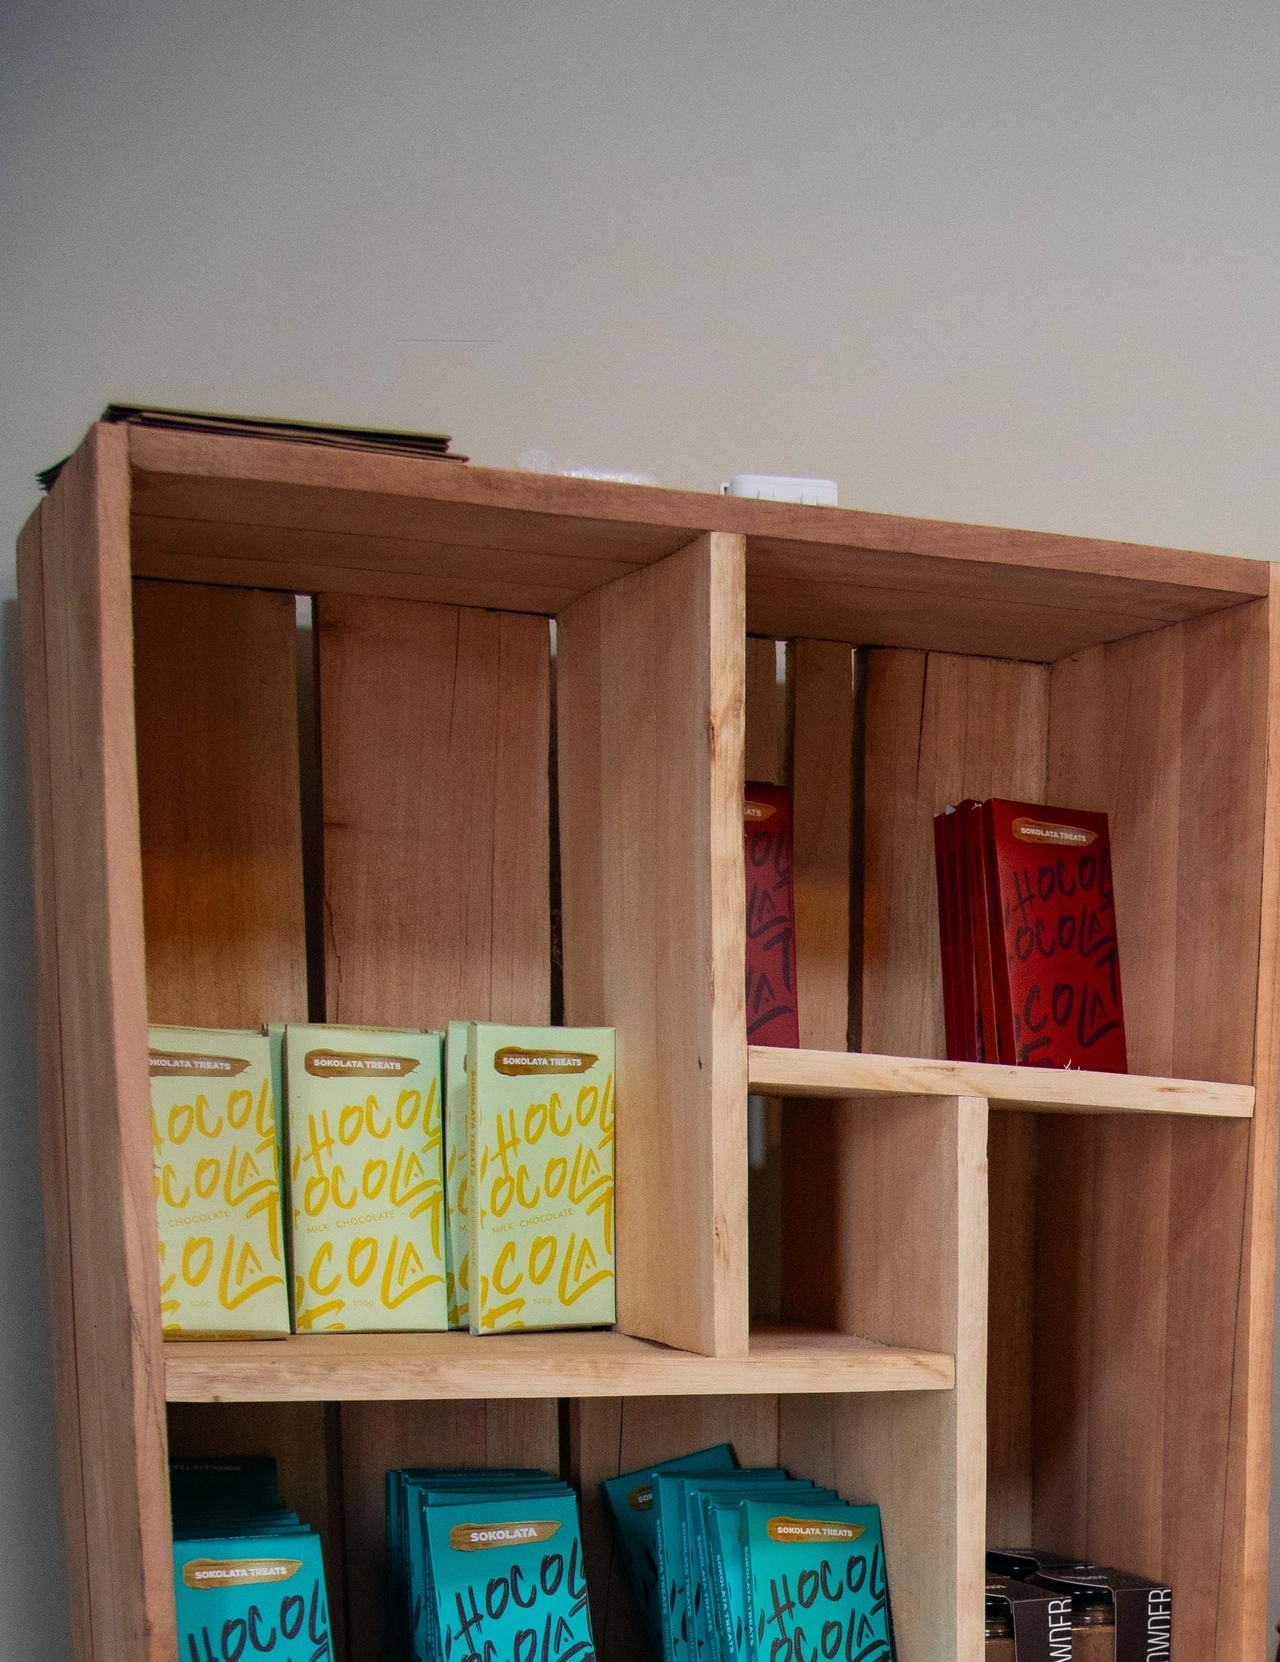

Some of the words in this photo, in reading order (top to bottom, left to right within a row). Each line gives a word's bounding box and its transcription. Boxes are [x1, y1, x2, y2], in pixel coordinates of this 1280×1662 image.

[1020, 826, 1059, 839] SOKOLATA
[1060, 831, 1087, 843] TREATS
[193, 1060, 231, 1071] TREATS
[313, 1058, 364, 1069] SOKOLATA
[365, 1060, 402, 1071] TREATS
[502, 1056, 549, 1067] SOKOLATA
[549, 1057, 582, 1068] TREATS
[167, 1210, 231, 1228] CHOCOLATE
[306, 1223, 330, 1235] MILK
[335, 1210, 396, 1228] CHOCOLATE
[492, 1222, 514, 1235] MILK
[519, 1207, 574, 1228] CHOCOLATE
[470, 1527, 538, 1542] SOKOLATA
[777, 1526, 821, 1536] SOKOLATA
[821, 1528, 853, 1537] TREATS
[194, 1569, 249, 1580] SOKOLATA
[249, 1566, 288, 1577] TREATS
[724, 1610, 735, 1654] TREATS
